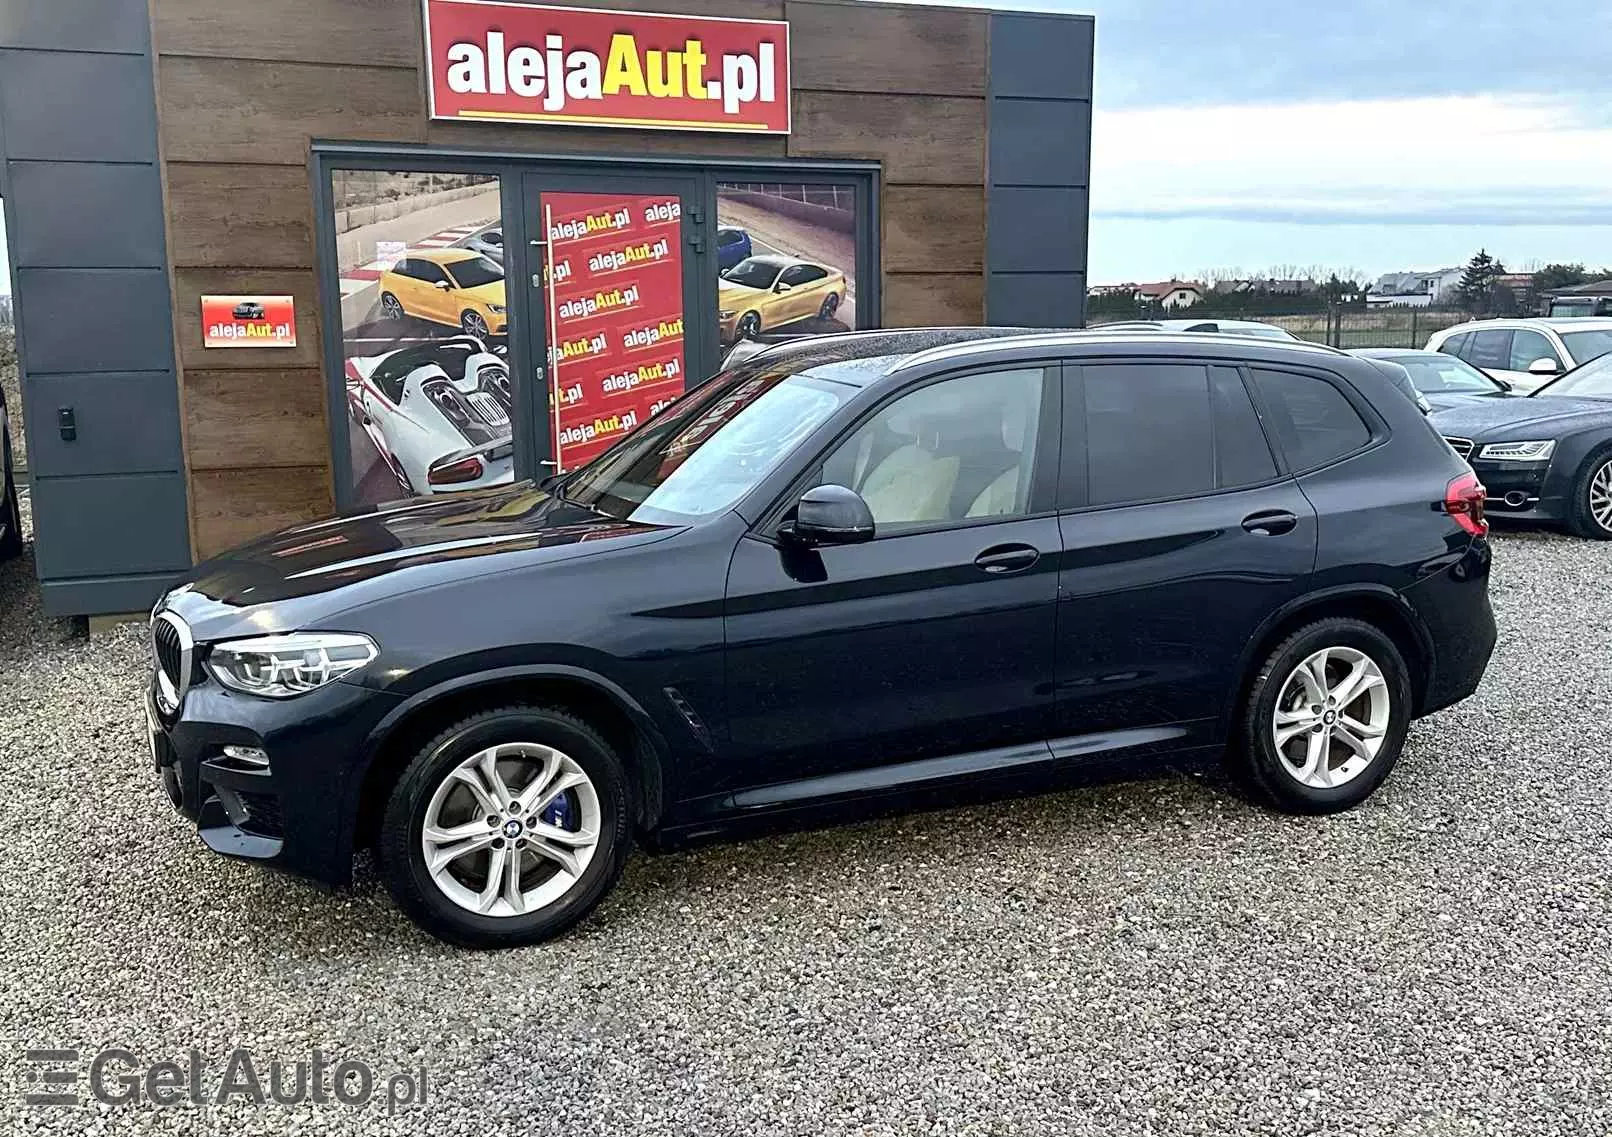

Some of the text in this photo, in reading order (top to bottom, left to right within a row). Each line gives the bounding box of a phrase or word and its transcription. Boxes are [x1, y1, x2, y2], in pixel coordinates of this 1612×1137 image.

[447, 31, 776, 114] alejaAut.pl
[551, 208, 631, 240] alejaAut.pl
[589, 239, 669, 272] alejaAut.pl
[559, 285, 640, 318] alejaAut.pl
[209, 322, 291, 341] alejaAut.pl
[623, 319, 683, 347] alejaAut
[602, 358, 680, 390] alejaAut.pl
[560, 410, 638, 443] alejaAut.pl
